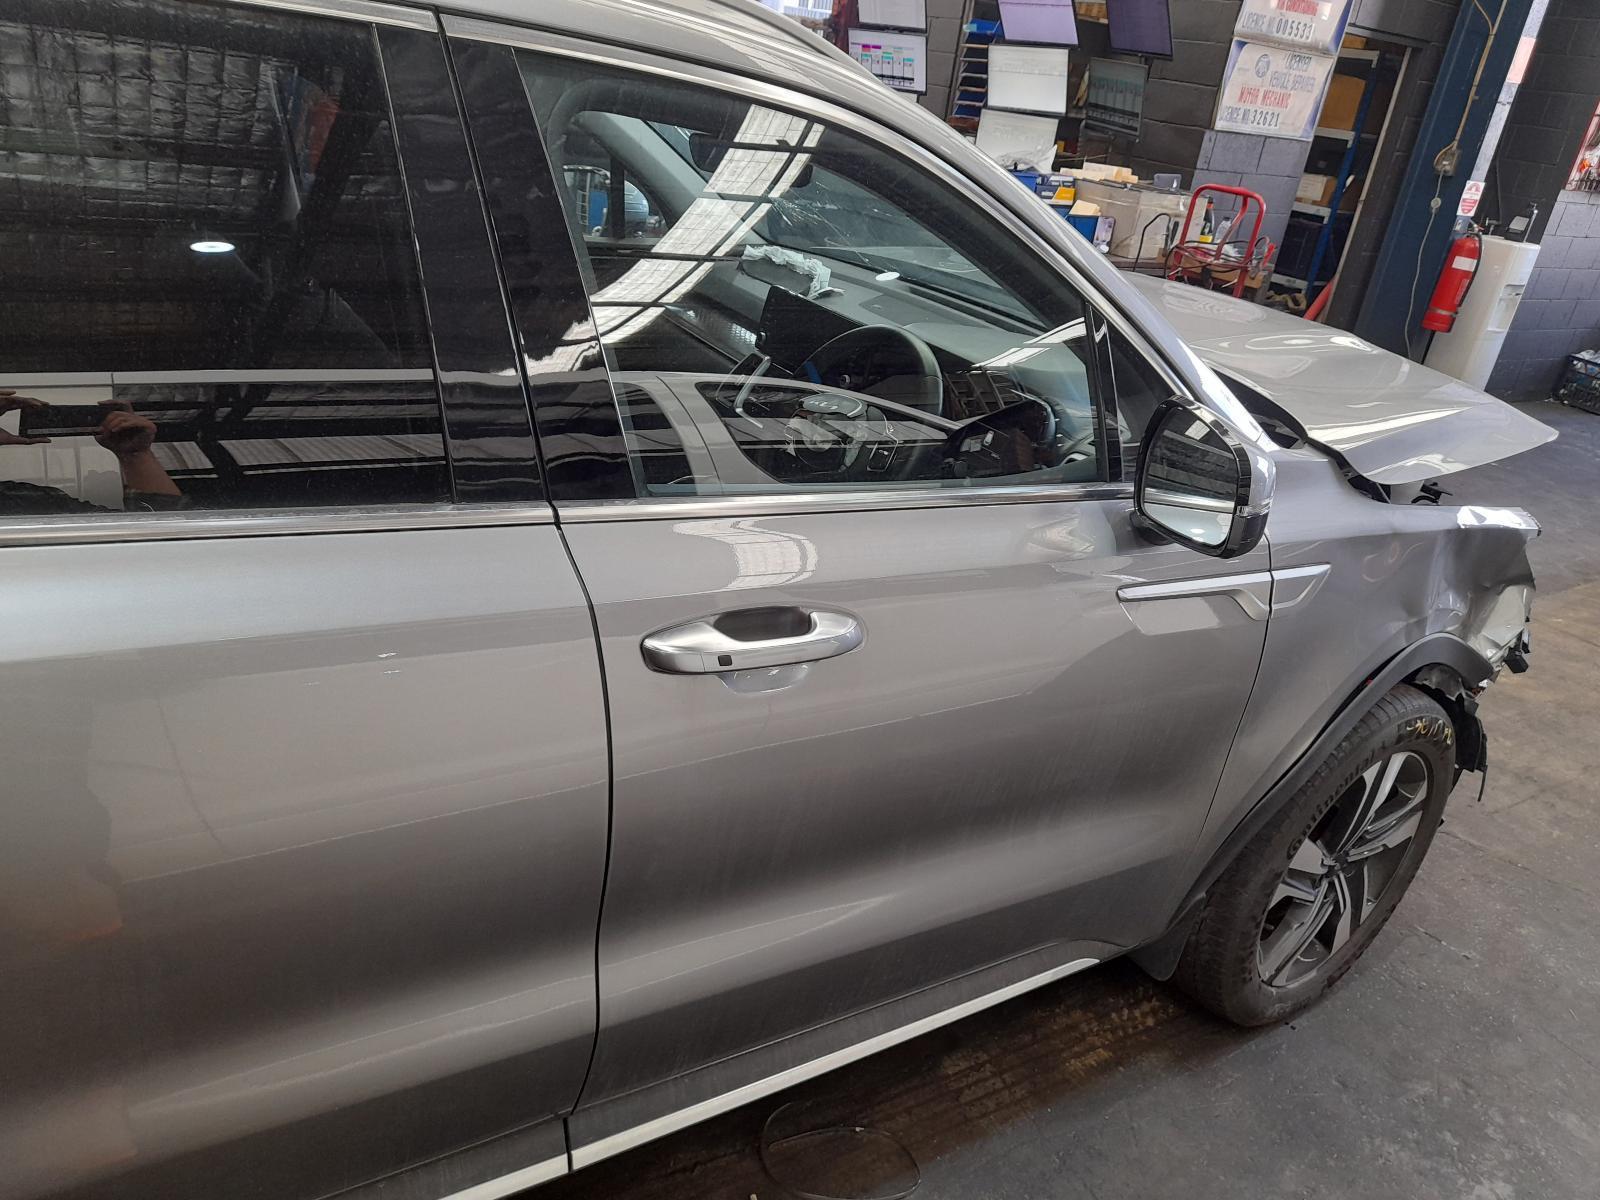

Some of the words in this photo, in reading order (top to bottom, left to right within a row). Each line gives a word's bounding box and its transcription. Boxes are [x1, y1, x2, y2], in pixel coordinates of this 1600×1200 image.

[1238, 86, 1260, 105] MOTOR
[1260, 89, 1292, 109] MECHANIC
[1251, 109, 1280, 128] 32621
